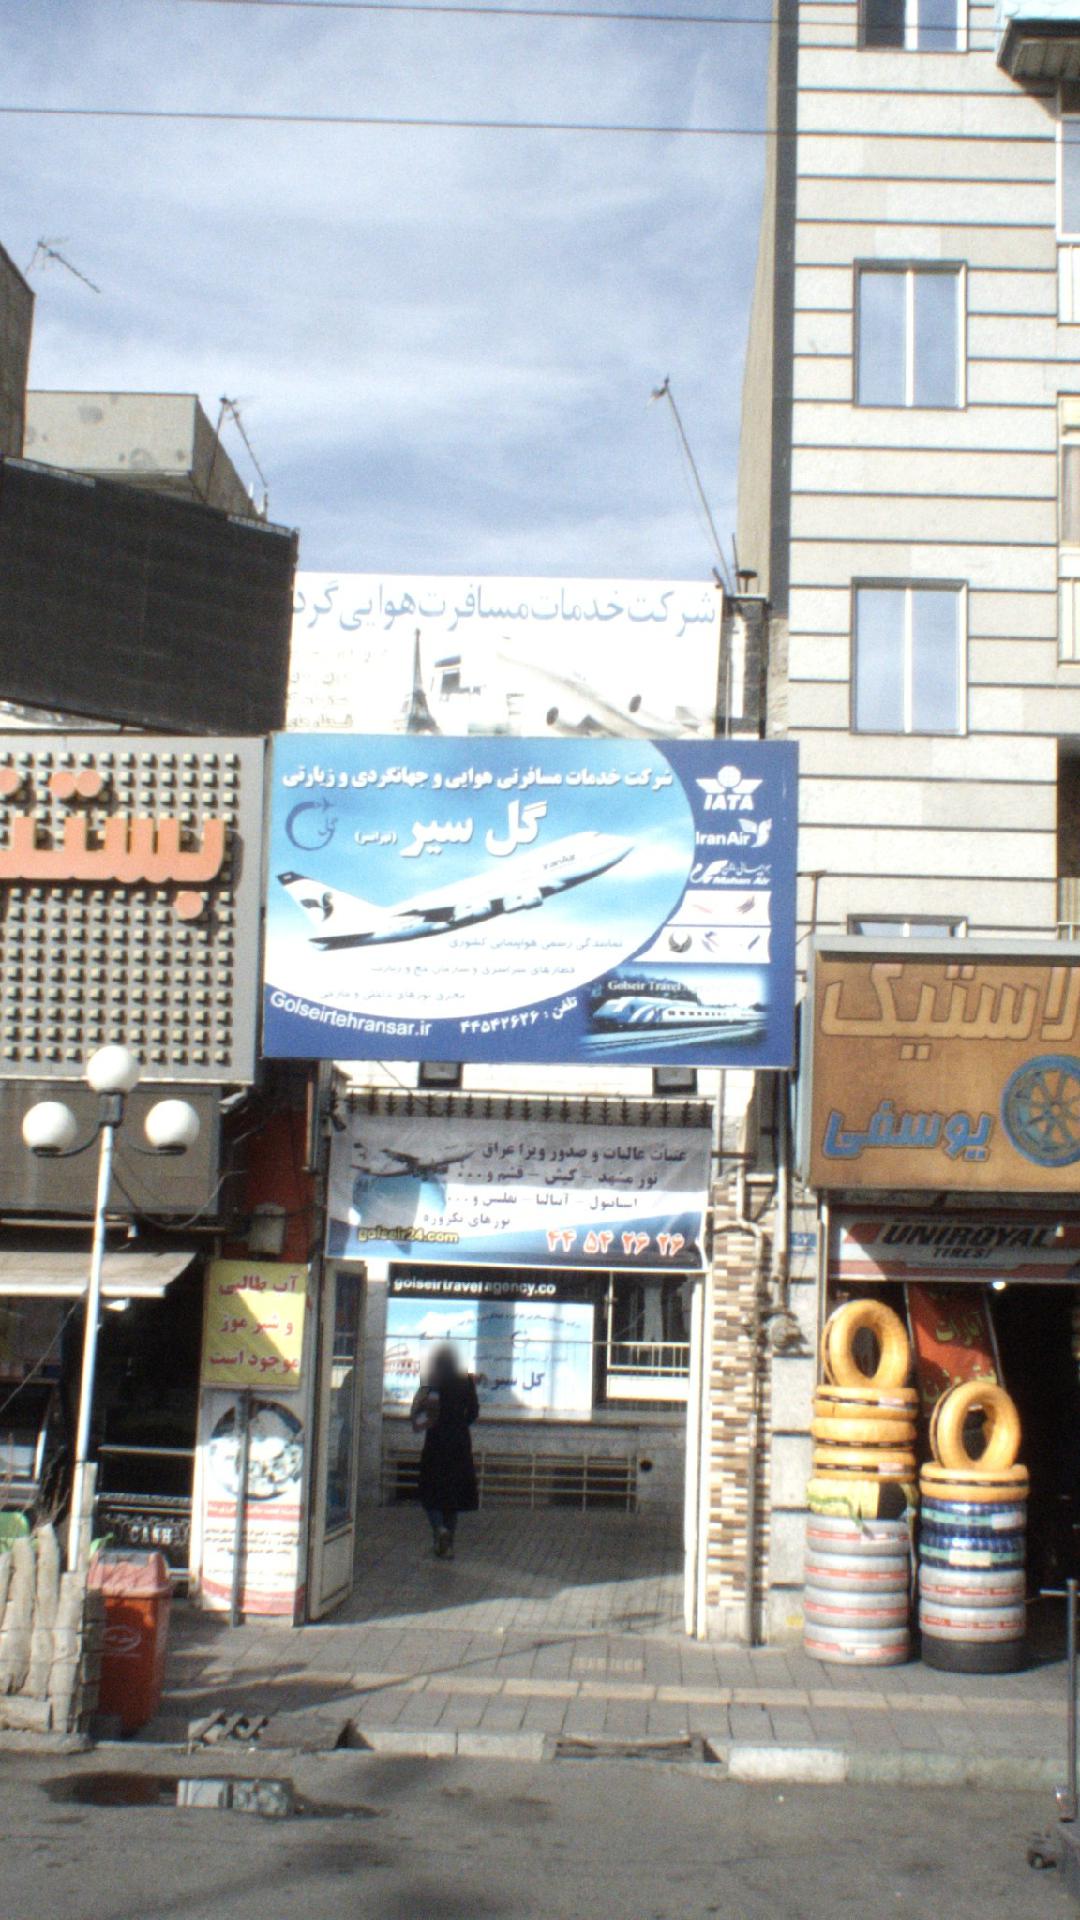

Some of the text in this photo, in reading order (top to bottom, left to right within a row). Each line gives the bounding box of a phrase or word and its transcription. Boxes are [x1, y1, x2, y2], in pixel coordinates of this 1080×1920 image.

[293, 581, 716, 637] شرکت خدمات مسافرت هوایی گرد
[282, 765, 672, 791] شرکت خدمات مسافرتی هوایی و جهانگردی و زیارتی
[704, 795, 754, 811] IATA
[400, 816, 473, 857] سیر
[485, 800, 547, 857] گل
[0, 768, 224, 920] بستن
[270, 991, 432, 1036] Golseirtehransar.ir
[821, 964, 1080, 1061] لاستیک
[824, 1100, 993, 1161] یوسفی
[482, 1142, 515, 1160] عراق
[550, 1147, 587, 1162] صدور
[592, 1148, 599, 1162] و
[603, 1146, 645, 1161] عالیات
[498, 1166, 523, 1182] قشم
[545, 1168, 577, 1185] کیش
[598, 1171, 633, 1184] مشهد
[639, 1172, 658, 1189] تور
[547, 1230, 685, 1256] ۴۴ ۵۴ ۲۶ ۲۶
[882, 1225, 1050, 1247] UNIROYAL
[218, 1275, 299, 1296] آب طالبی
[220, 1314, 293, 1336] و شیر موز
[208, 1350, 298, 1373] موجود است
[522, 1371, 545, 1390] گل
